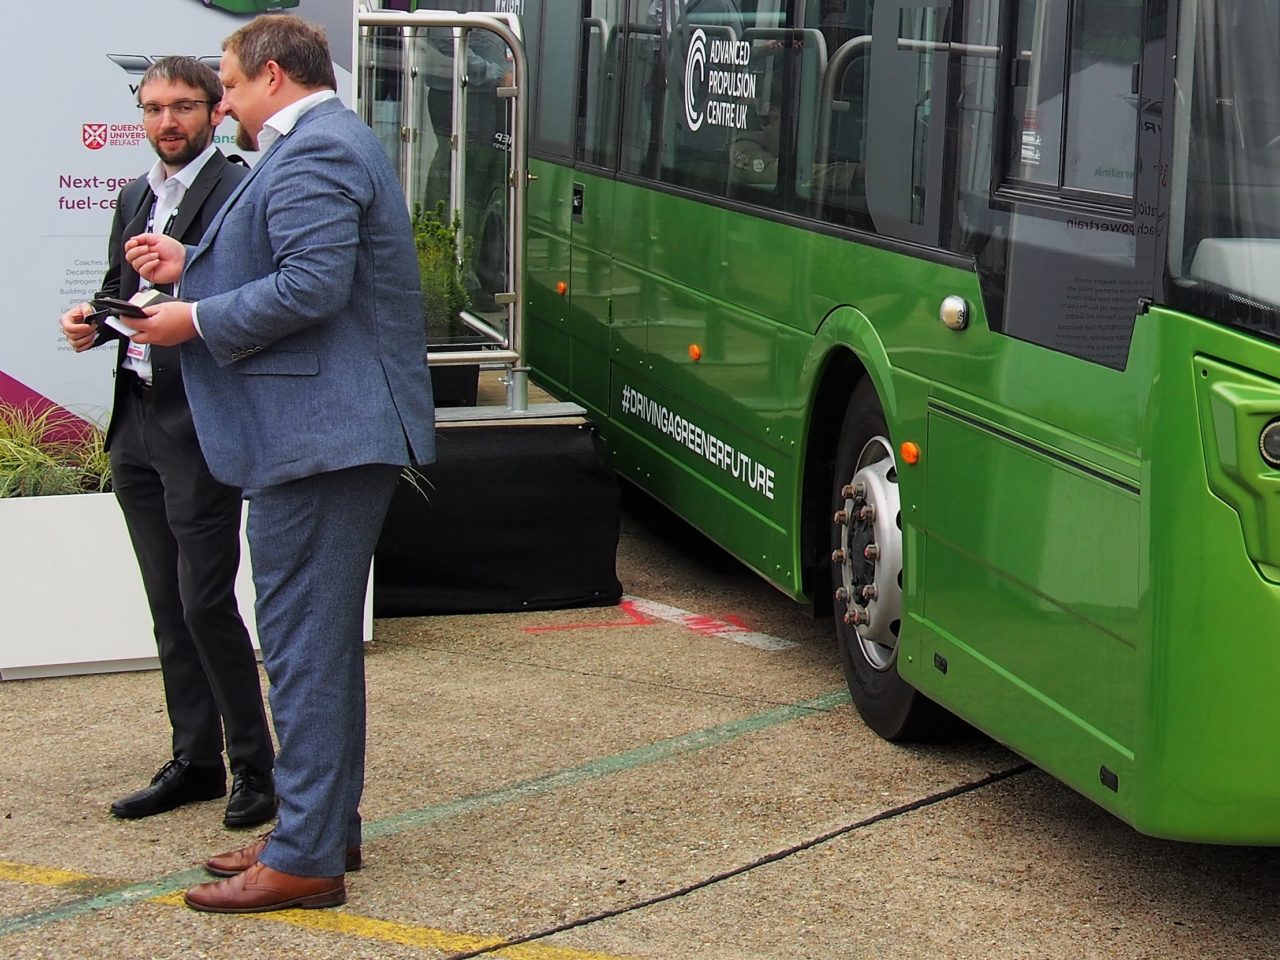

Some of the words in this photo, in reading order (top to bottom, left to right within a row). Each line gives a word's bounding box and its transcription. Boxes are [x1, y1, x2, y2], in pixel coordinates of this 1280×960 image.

[709, 40, 750, 65] ADVANCED
[708, 70, 756, 98] PROPULSION
[707, 100, 736, 127] CENTRE
[736, 103, 748, 130] UK
[110, 124, 145, 132] QUEEN'S
[59, 175, 137, 191] Next-ge
[58, 196, 119, 210] fuel-ce
[621, 384, 775, 500] #DRIVINGAGREENERFUTURE
